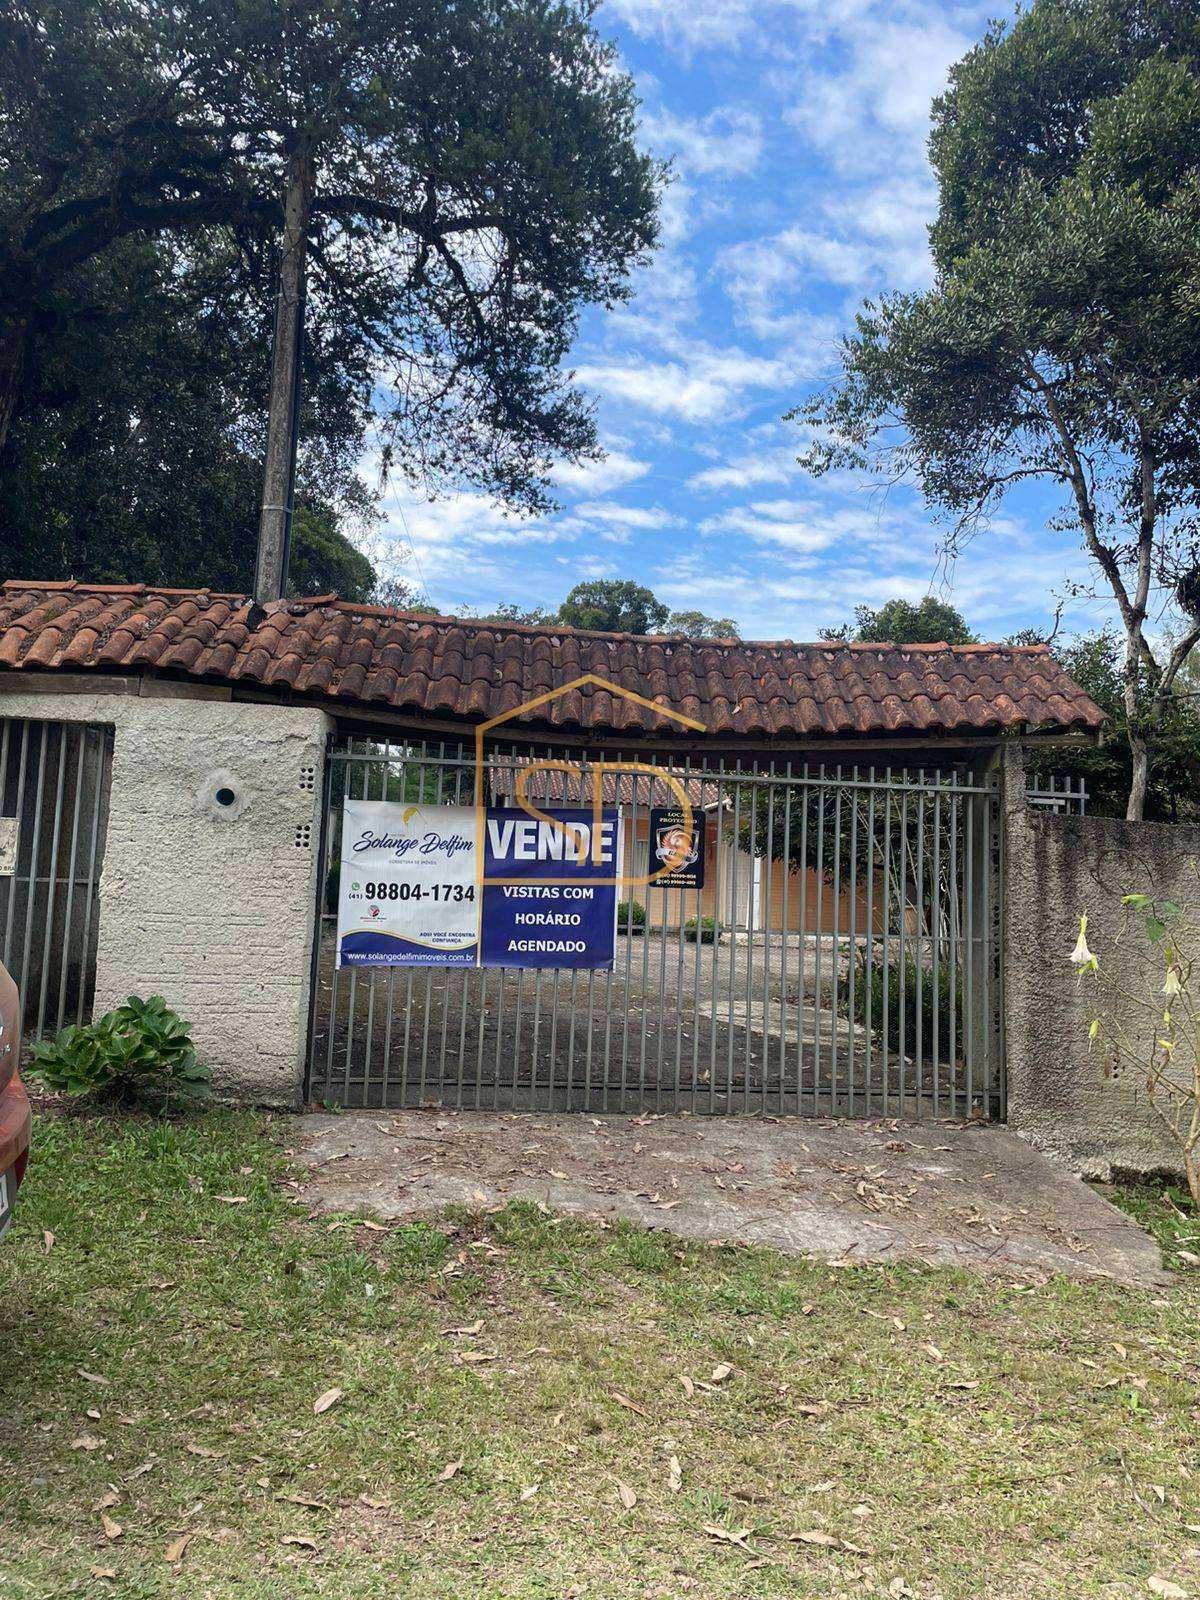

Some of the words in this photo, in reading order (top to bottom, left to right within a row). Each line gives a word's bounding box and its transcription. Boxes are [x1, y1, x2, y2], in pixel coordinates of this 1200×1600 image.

[353, 830, 419, 857] Solange
[419, 832, 474, 858] Delfim
[487, 819, 614, 862] VENDE
[348, 892, 363, 900] (41)
[365, 882, 475, 902] 98804-1734
[503, 886, 560, 899] VISITAS
[563, 887, 594, 899] COM
[515, 910, 581, 926] HORÁRIO
[508, 940, 586, 953] AGENDADO
[347, 951, 474, 963] www.solangedelfimimoveis.com.br
